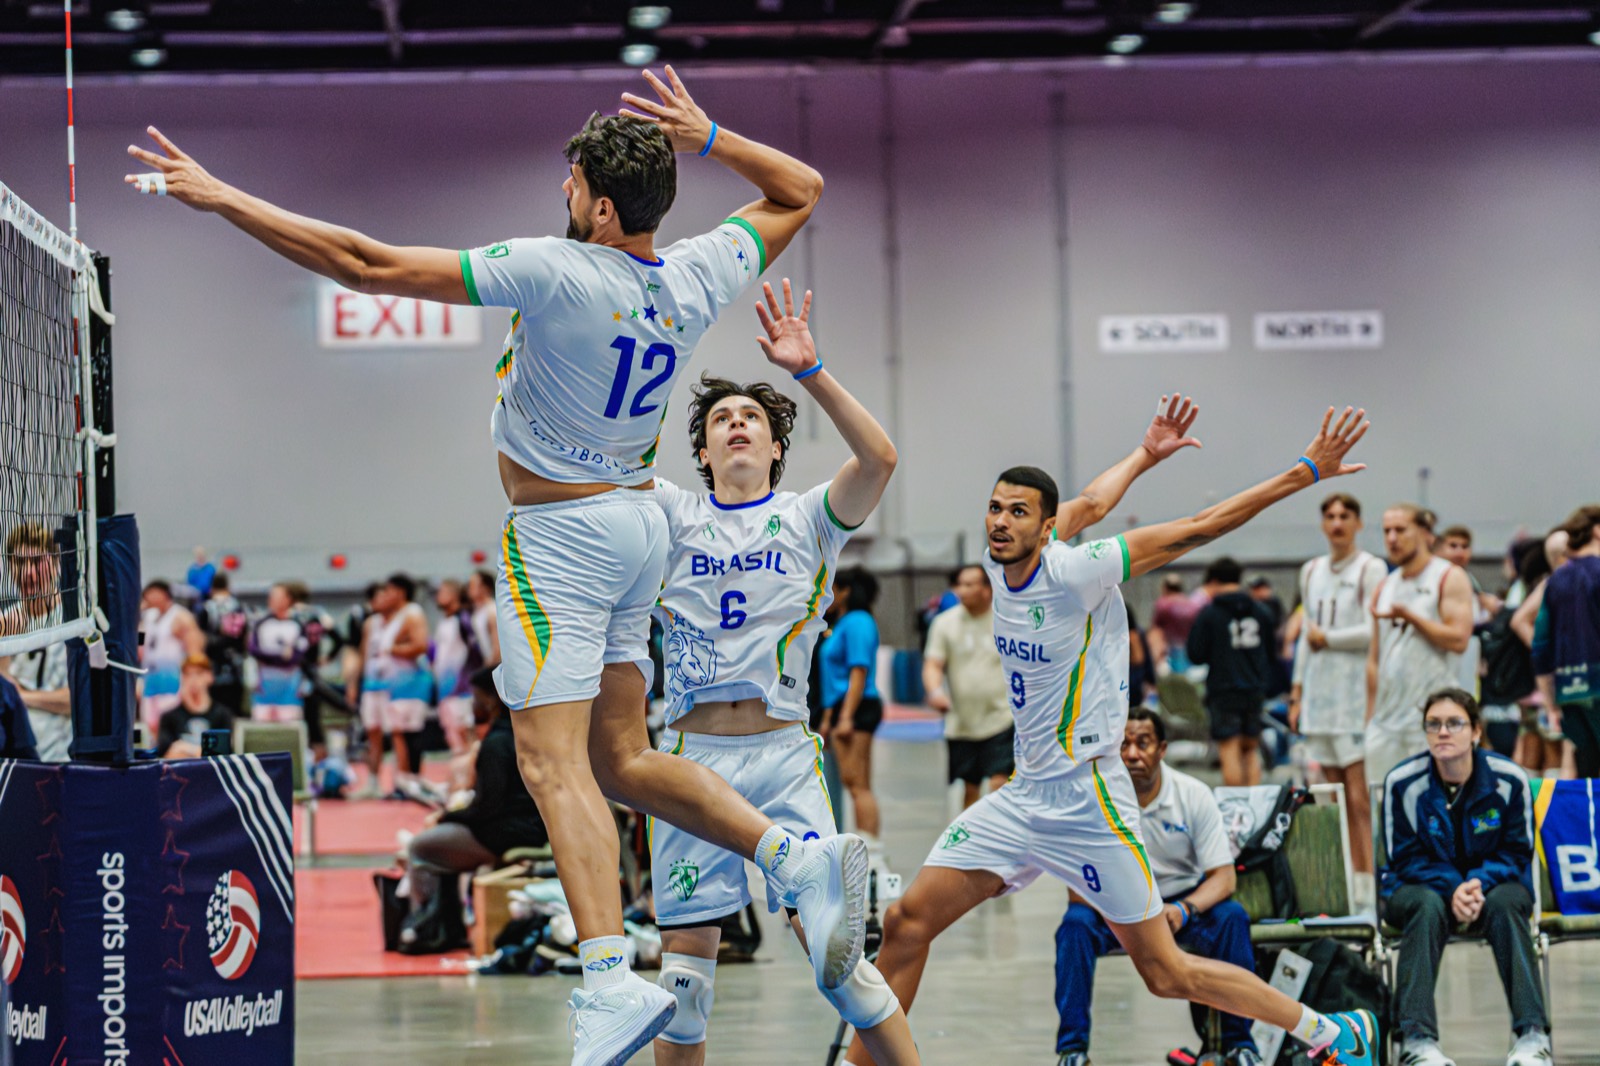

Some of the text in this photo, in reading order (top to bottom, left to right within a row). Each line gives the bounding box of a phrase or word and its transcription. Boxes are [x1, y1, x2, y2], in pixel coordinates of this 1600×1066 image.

[603, 335, 677, 420] 12
[691, 550, 787, 577] BRASIL
[719, 589, 748, 630] 6
[1010, 671, 1026, 710] 9
[1082, 863, 1102, 893] 9
[96, 852, 130, 950] sports
[184, 989, 283, 1037] USAVolleyball
